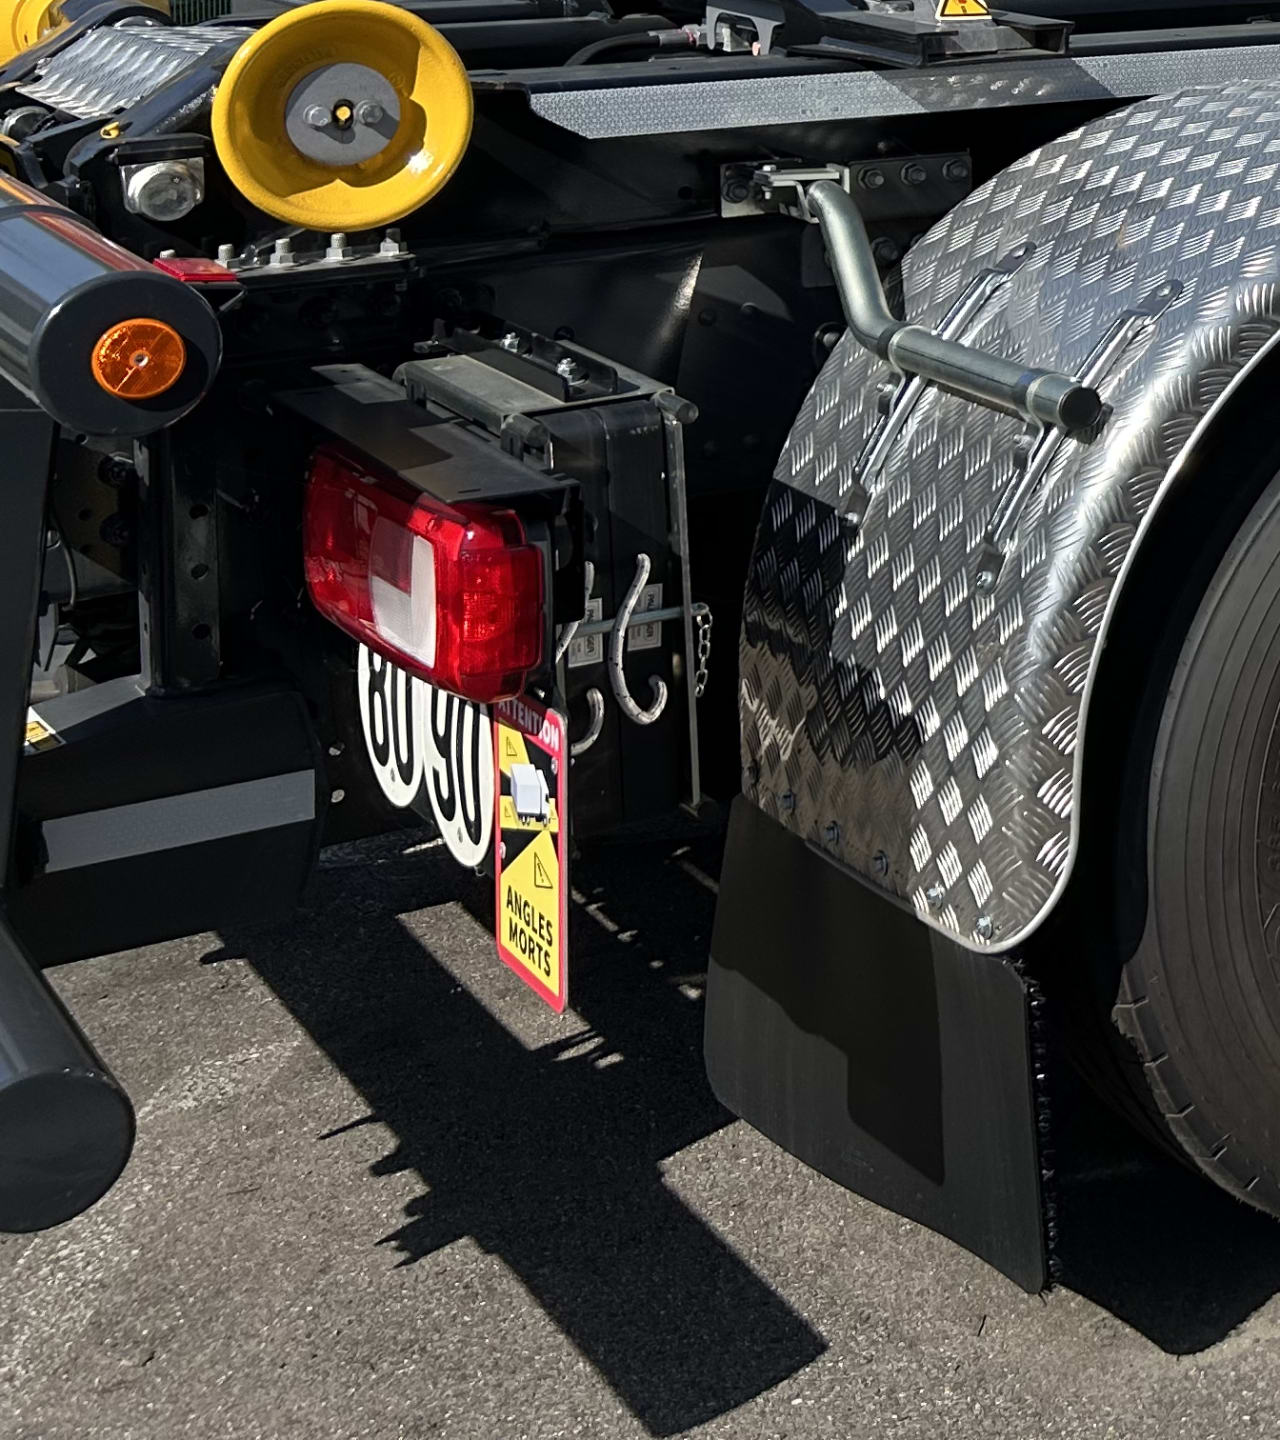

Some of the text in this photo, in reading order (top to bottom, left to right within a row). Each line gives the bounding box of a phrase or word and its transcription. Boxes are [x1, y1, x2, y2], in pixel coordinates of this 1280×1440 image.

[369, 647, 415, 788] 80
[499, 698, 561, 753] ATTENTION
[431, 683, 483, 847] 90
[506, 884, 553, 947] ANGLES
[509, 916, 551, 977] MORTS
